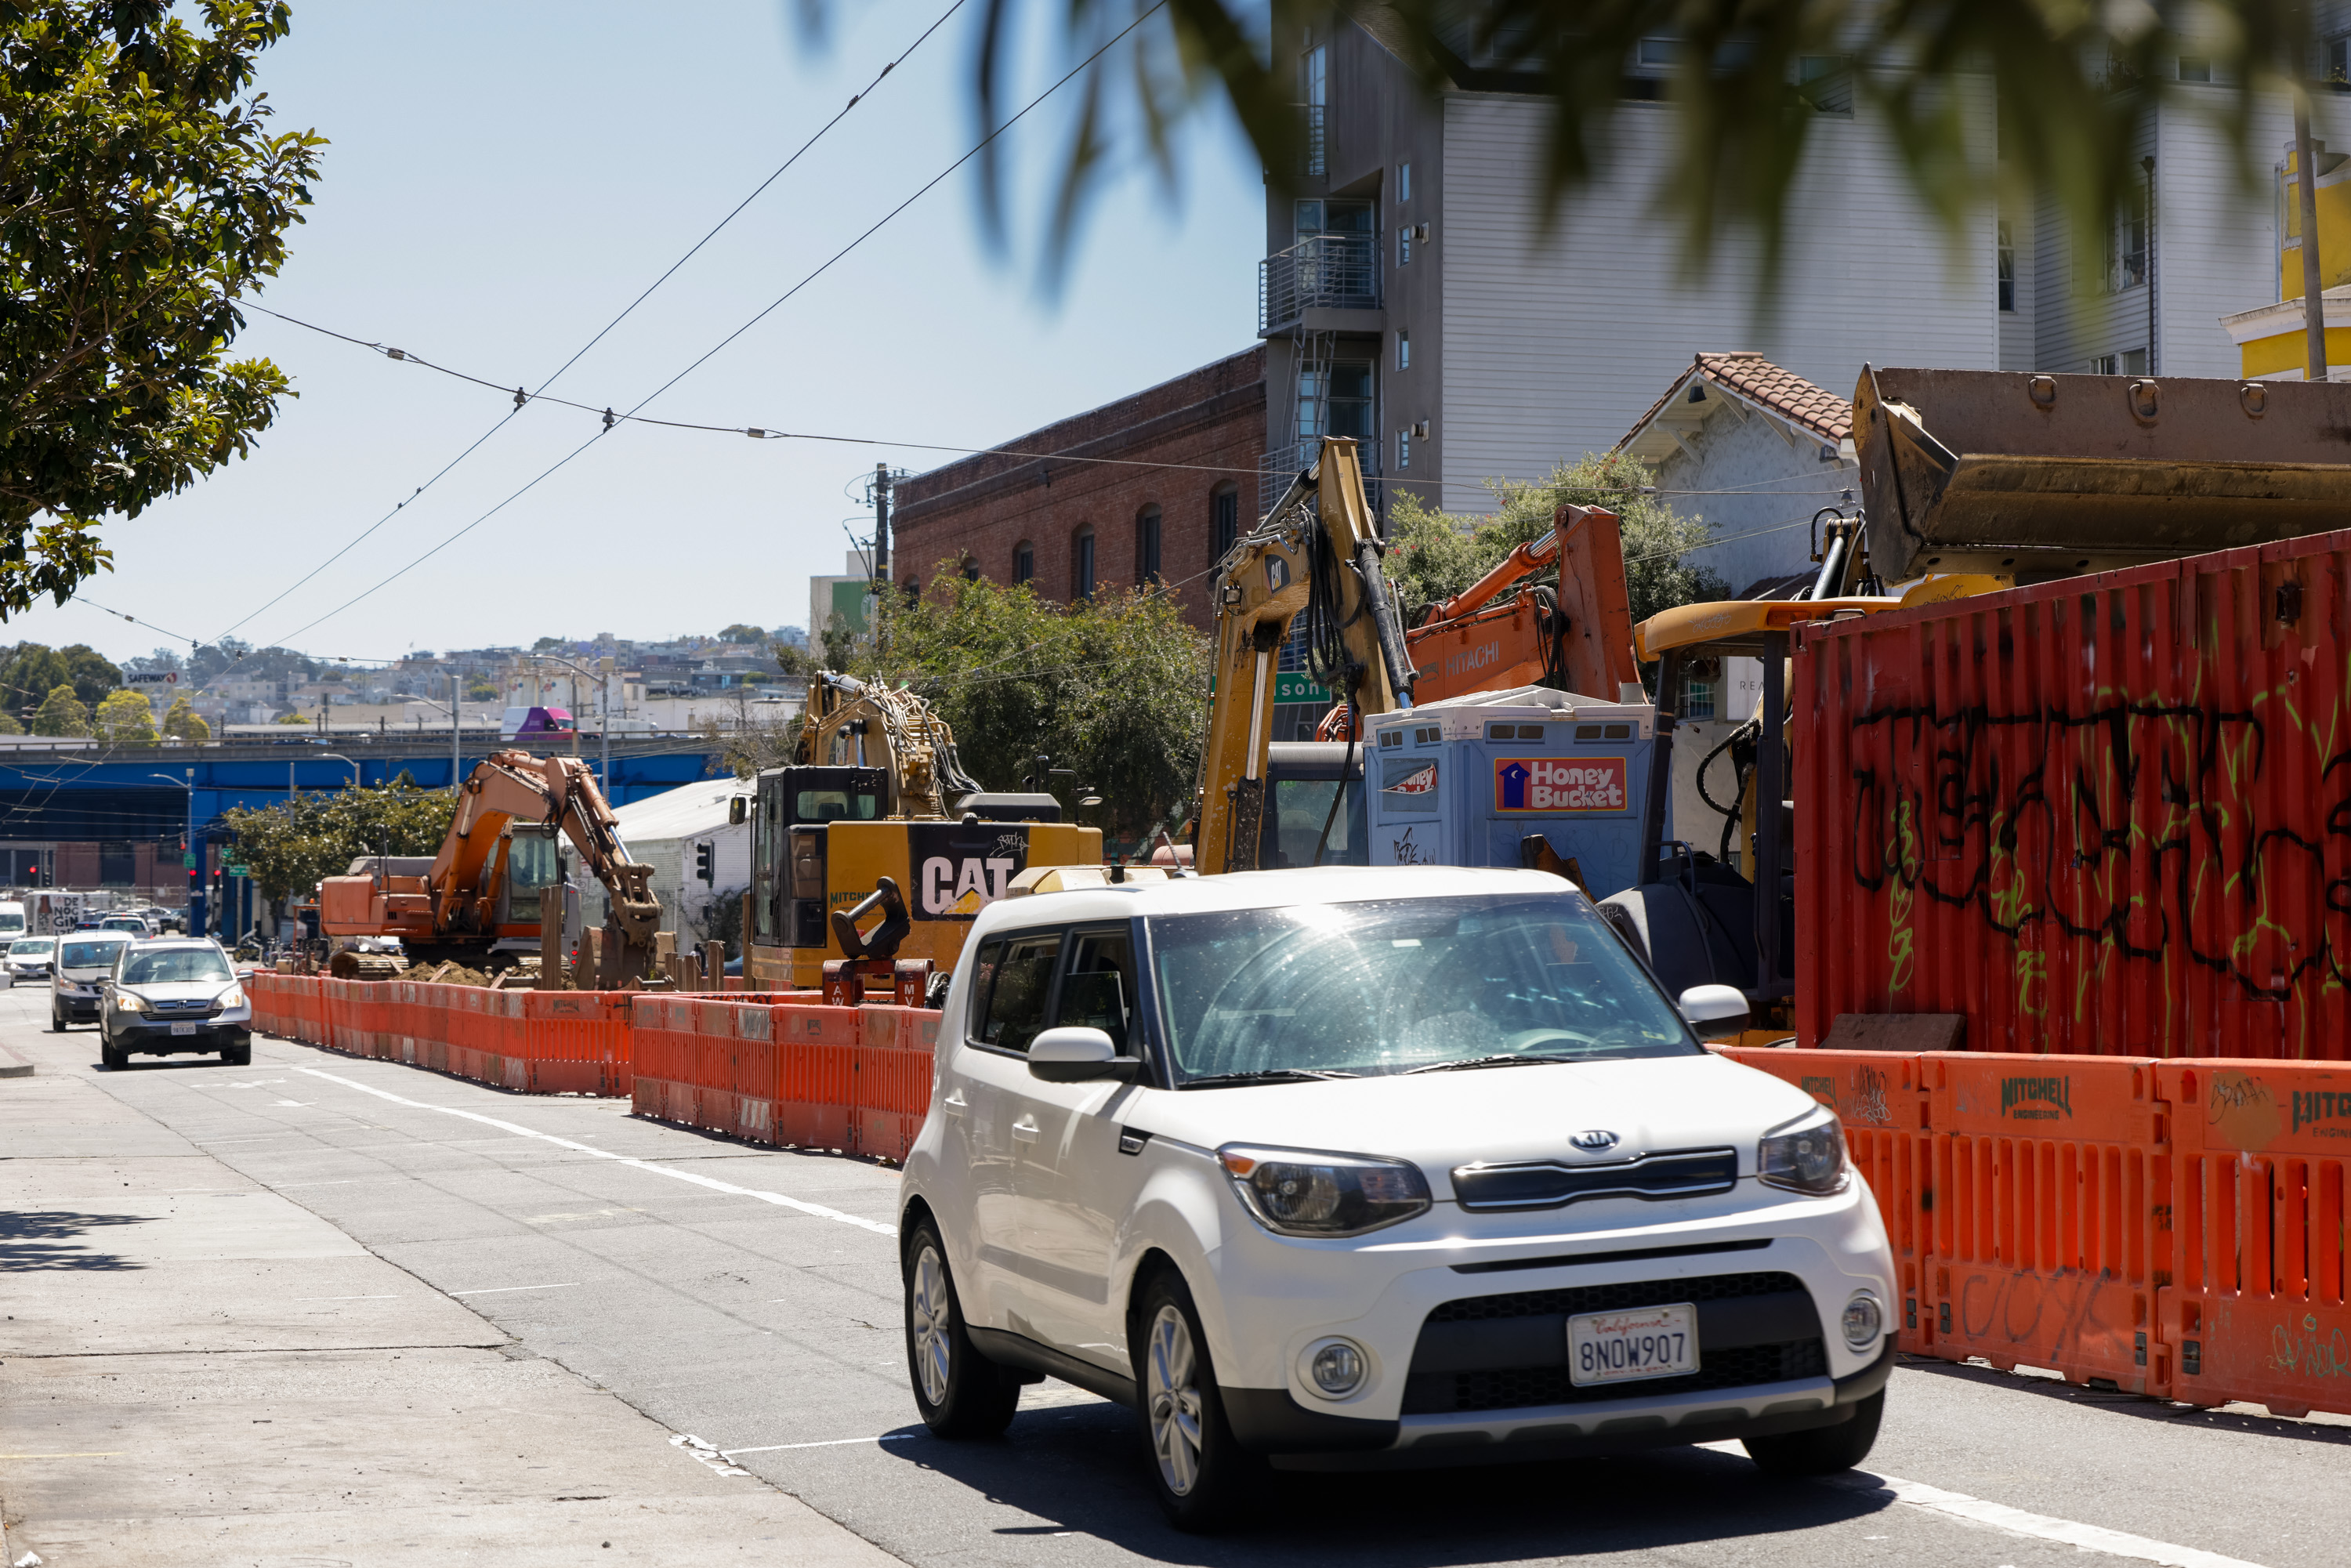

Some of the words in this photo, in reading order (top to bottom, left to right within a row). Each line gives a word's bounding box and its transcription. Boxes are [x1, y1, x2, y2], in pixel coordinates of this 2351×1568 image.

[1271, 559, 1282, 590] CAT
[1446, 641, 1498, 678] HITACHI
[128, 674, 167, 683] SAFEWAY
[1405, 770, 1434, 790] oney
[1531, 762, 1614, 790] Honey
[1531, 784, 1623, 809] Bucket
[922, 856, 1014, 914] CAT
[63, 896, 79, 907] DE
[1802, 1076, 1838, 1107] MITCHELL
[2001, 1076, 2073, 1118] MITCHELL
[2013, 1110, 2059, 1120] ENGINEERING
[1573, 1132, 1614, 1146] KIA
[1596, 1318, 1670, 1335] California
